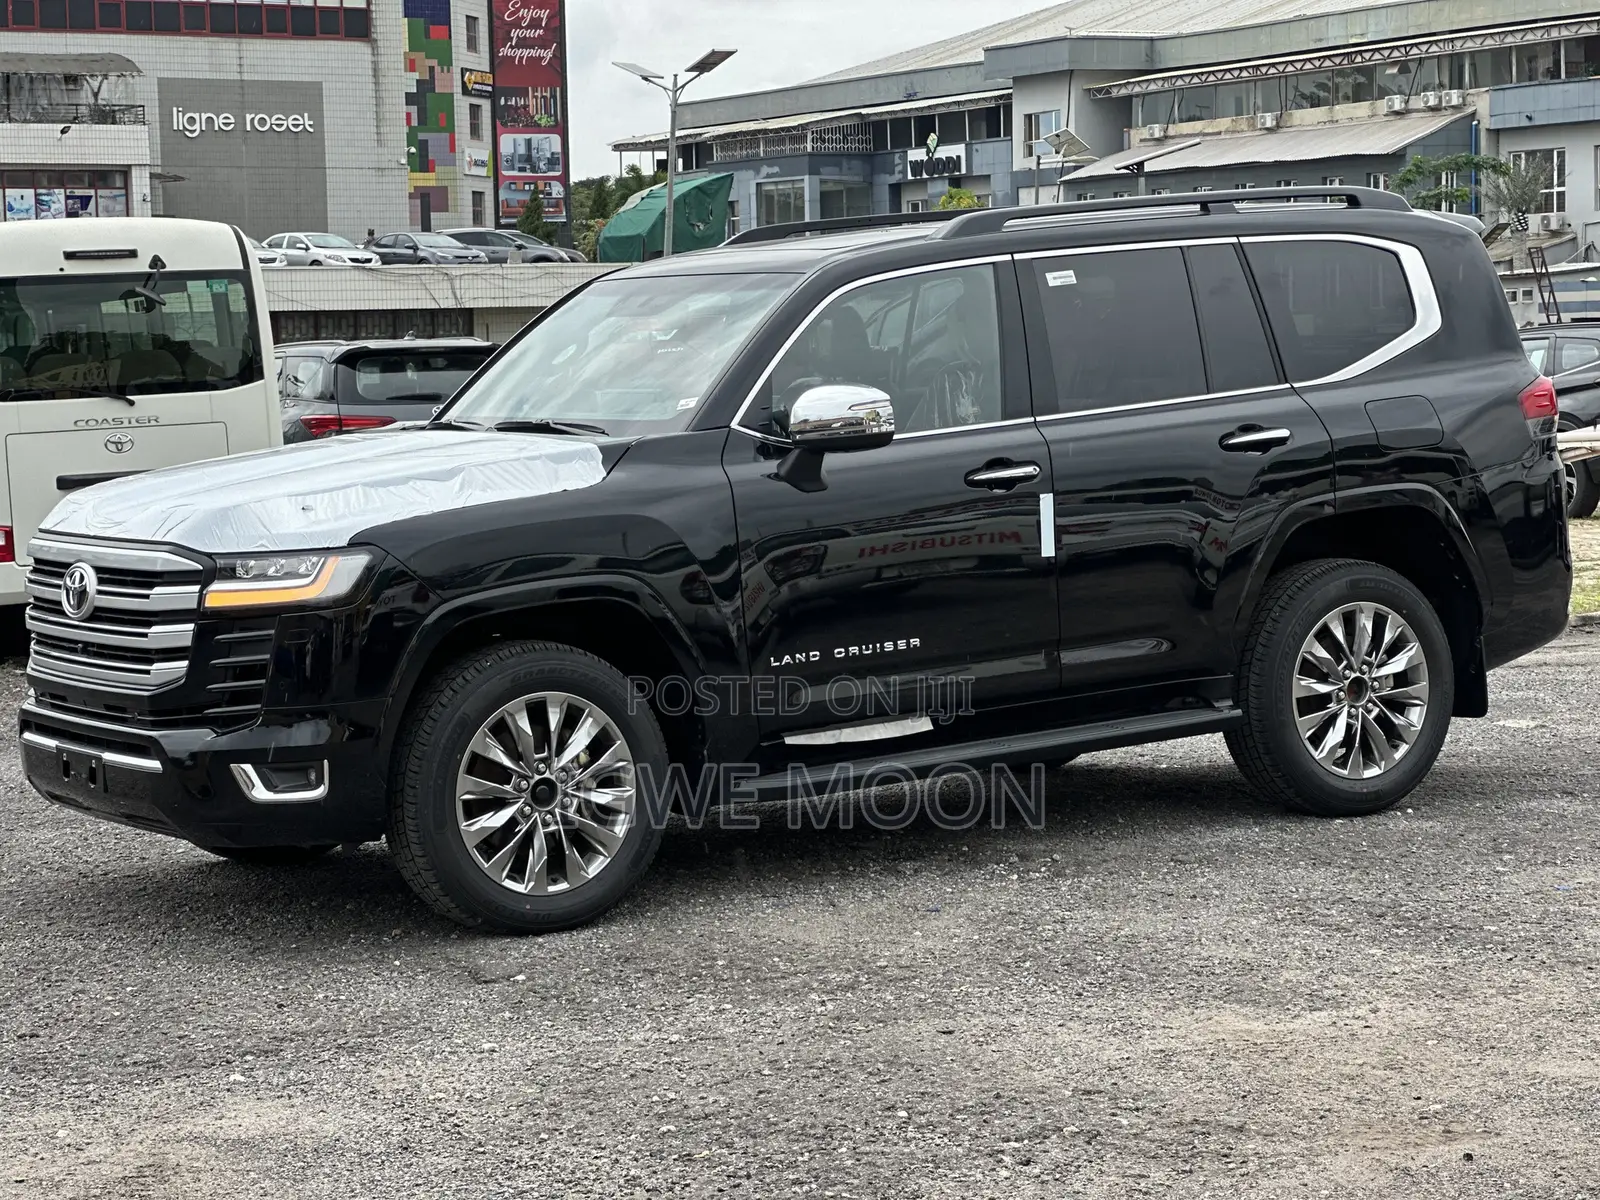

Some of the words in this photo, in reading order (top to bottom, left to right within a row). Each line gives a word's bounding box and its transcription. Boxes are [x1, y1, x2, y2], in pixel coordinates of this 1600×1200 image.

[504, 0, 550, 27] Enjoy
[510, 28, 545, 46] your
[498, 42, 557, 66] shopping!
[172, 106, 236, 138] ligne
[245, 112, 315, 133] roset
[73, 414, 160, 428] COASTER
[770, 651, 821, 667] LAND
[833, 638, 921, 658] CRUISER
